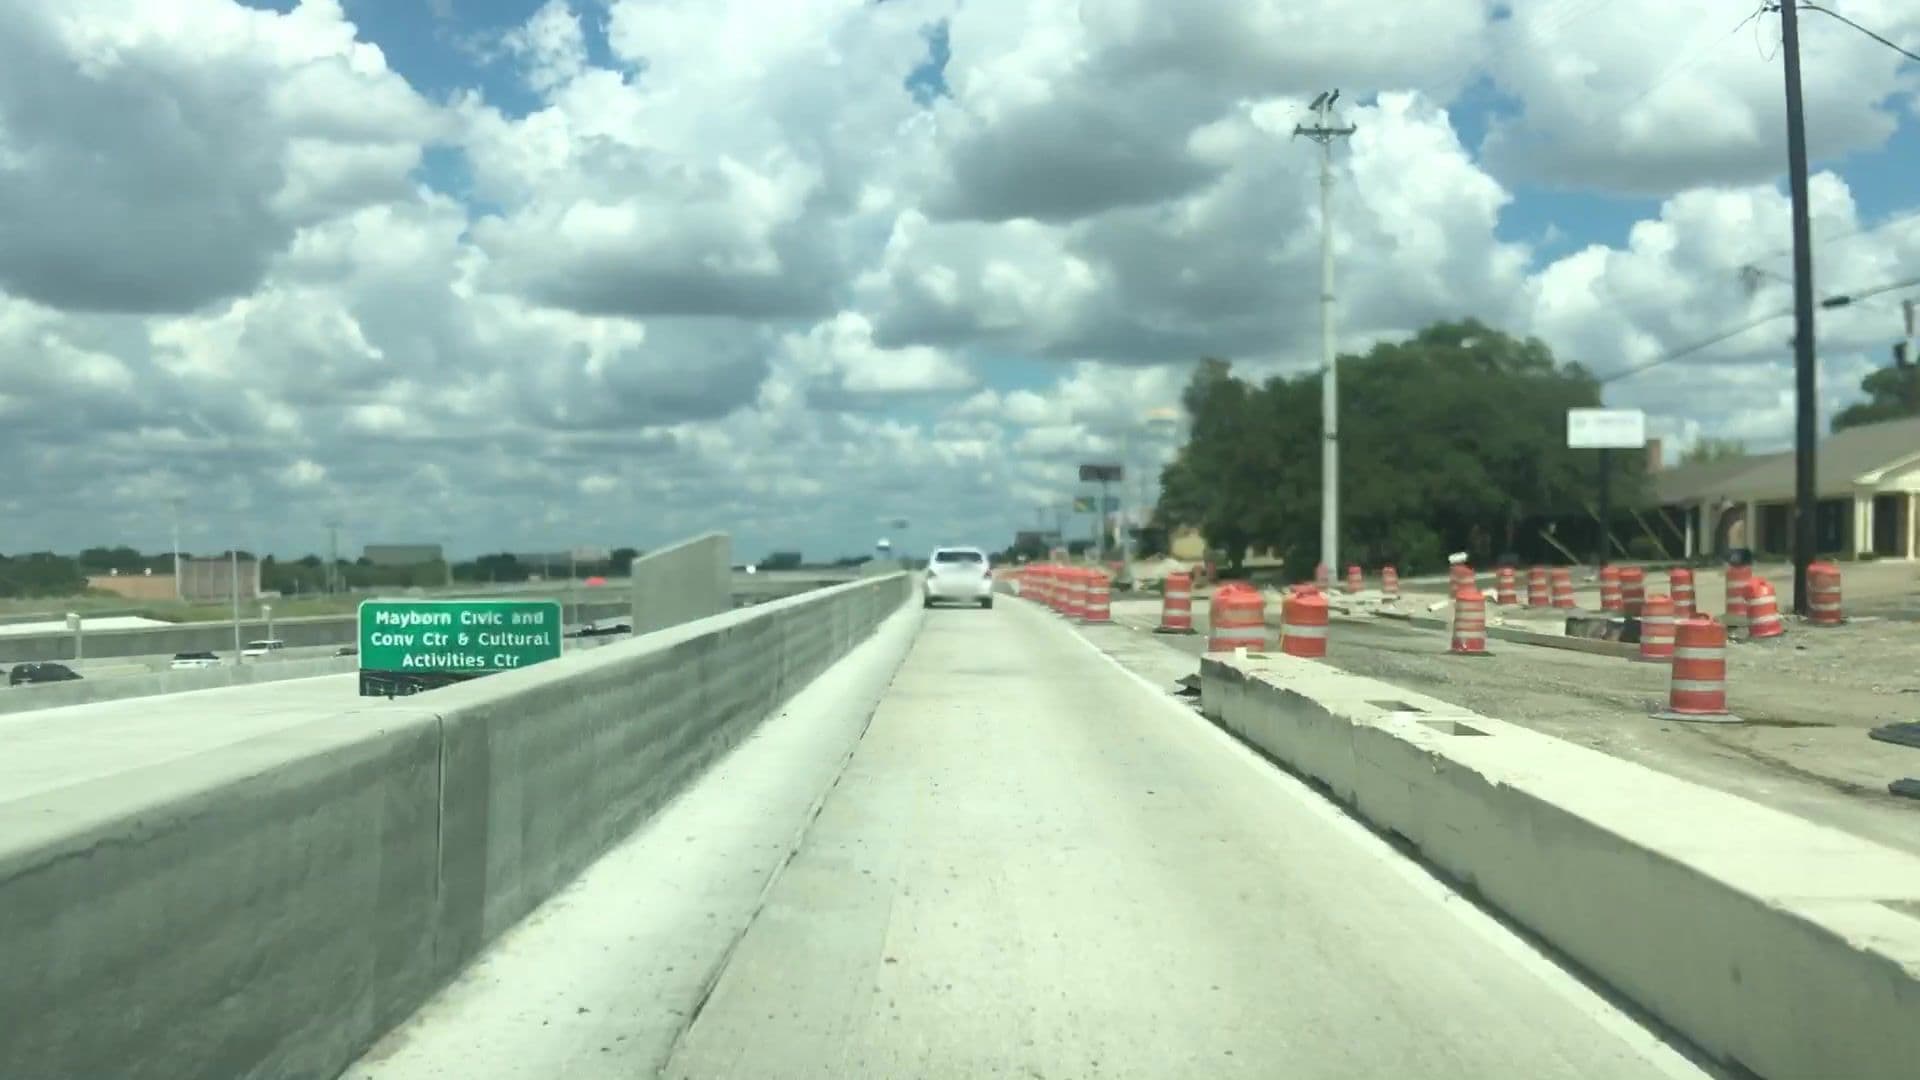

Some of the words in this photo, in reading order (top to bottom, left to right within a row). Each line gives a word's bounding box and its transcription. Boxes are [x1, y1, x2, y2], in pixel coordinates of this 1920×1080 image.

[376, 611, 451, 628] Mayborn
[460, 611, 503, 625] Civic
[512, 610, 544, 625] and
[371, 632, 414, 646] Conv
[423, 632, 448, 646] Ctr
[458, 632, 469, 646] &
[478, 632, 550, 646] Cultural
[402, 652, 485, 667] Activities
[494, 654, 520, 667] Ctr
